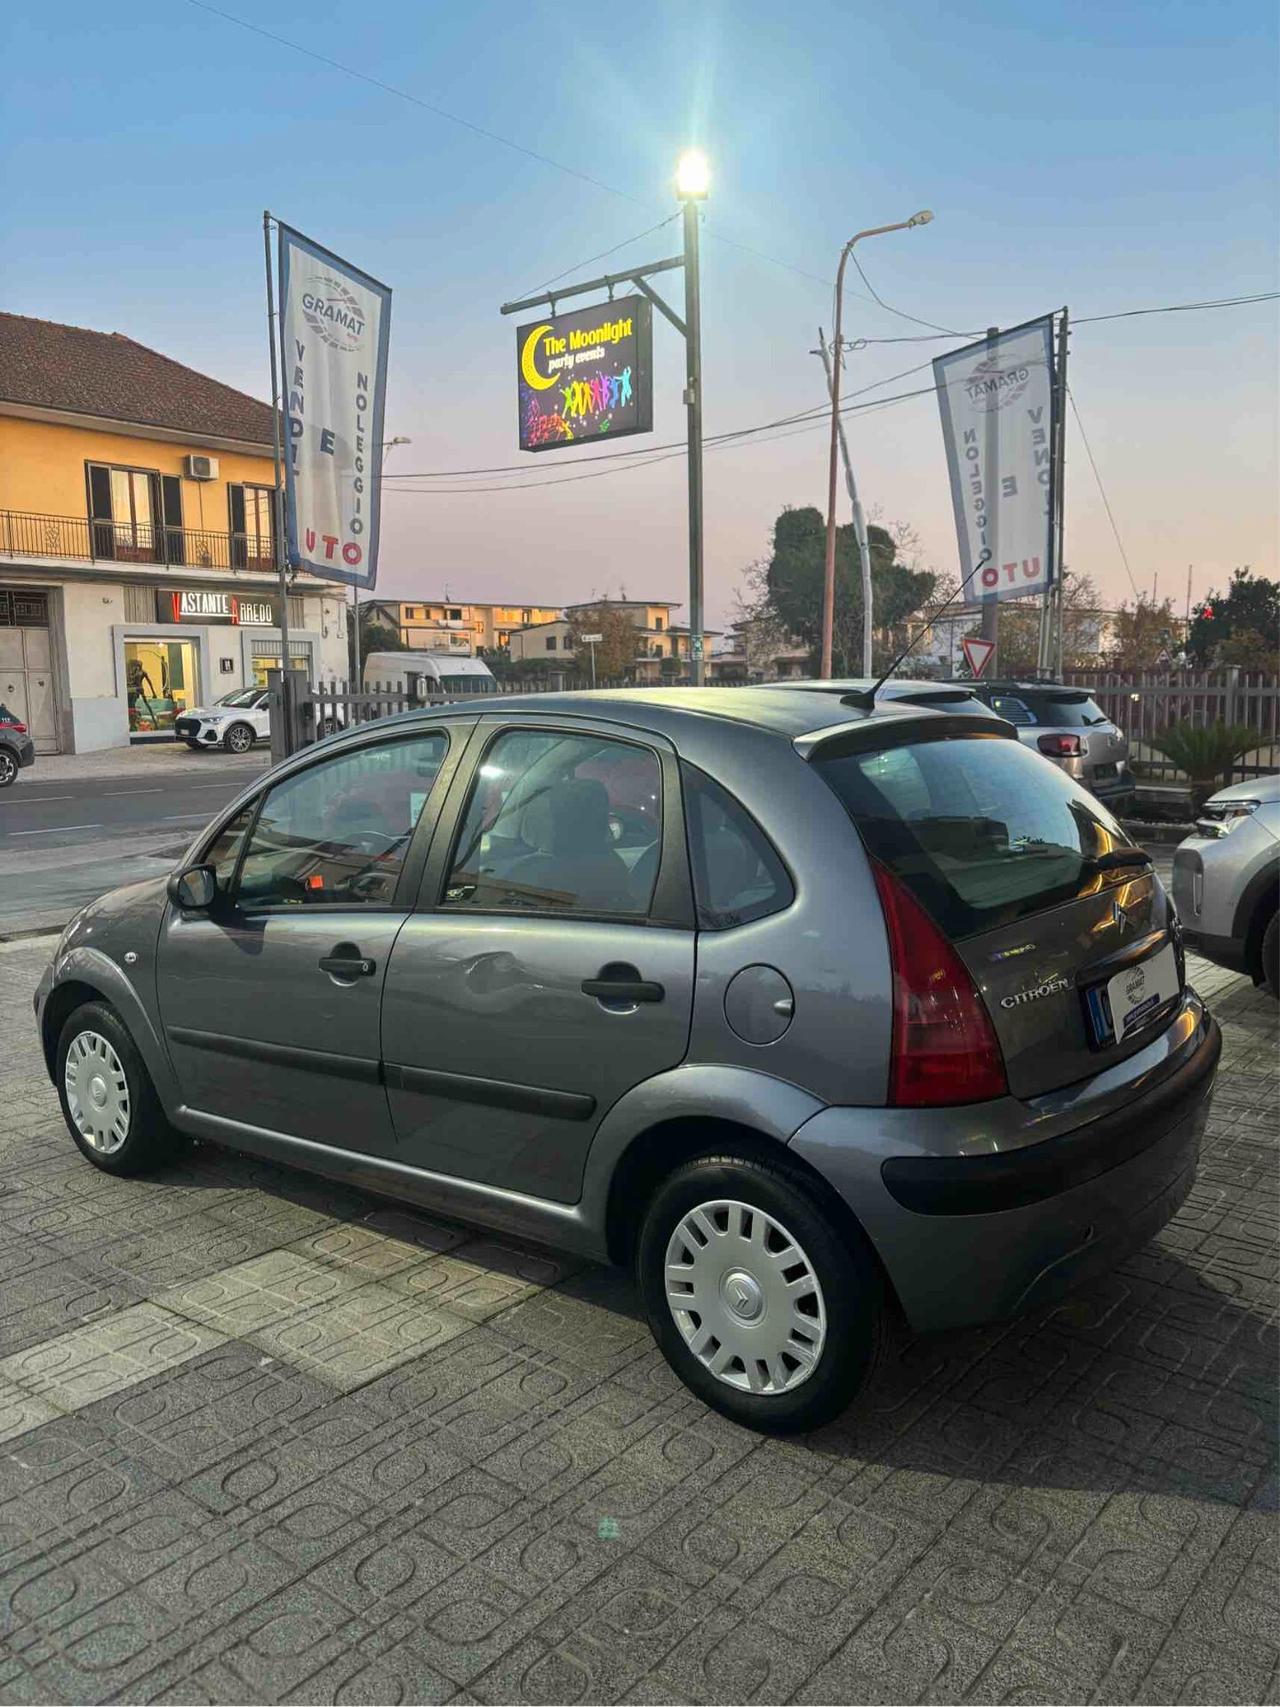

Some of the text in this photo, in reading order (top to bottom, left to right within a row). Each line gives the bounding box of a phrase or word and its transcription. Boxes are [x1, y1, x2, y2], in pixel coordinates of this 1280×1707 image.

[302, 293, 365, 335] GRAMAT
[543, 317, 632, 356] The Moonlight
[548, 345, 605, 374] party events
[320, 427, 335, 456] E
[350, 372, 368, 535] NOLEGGIO
[172, 592, 272, 625] VASTANTE ARREDO
